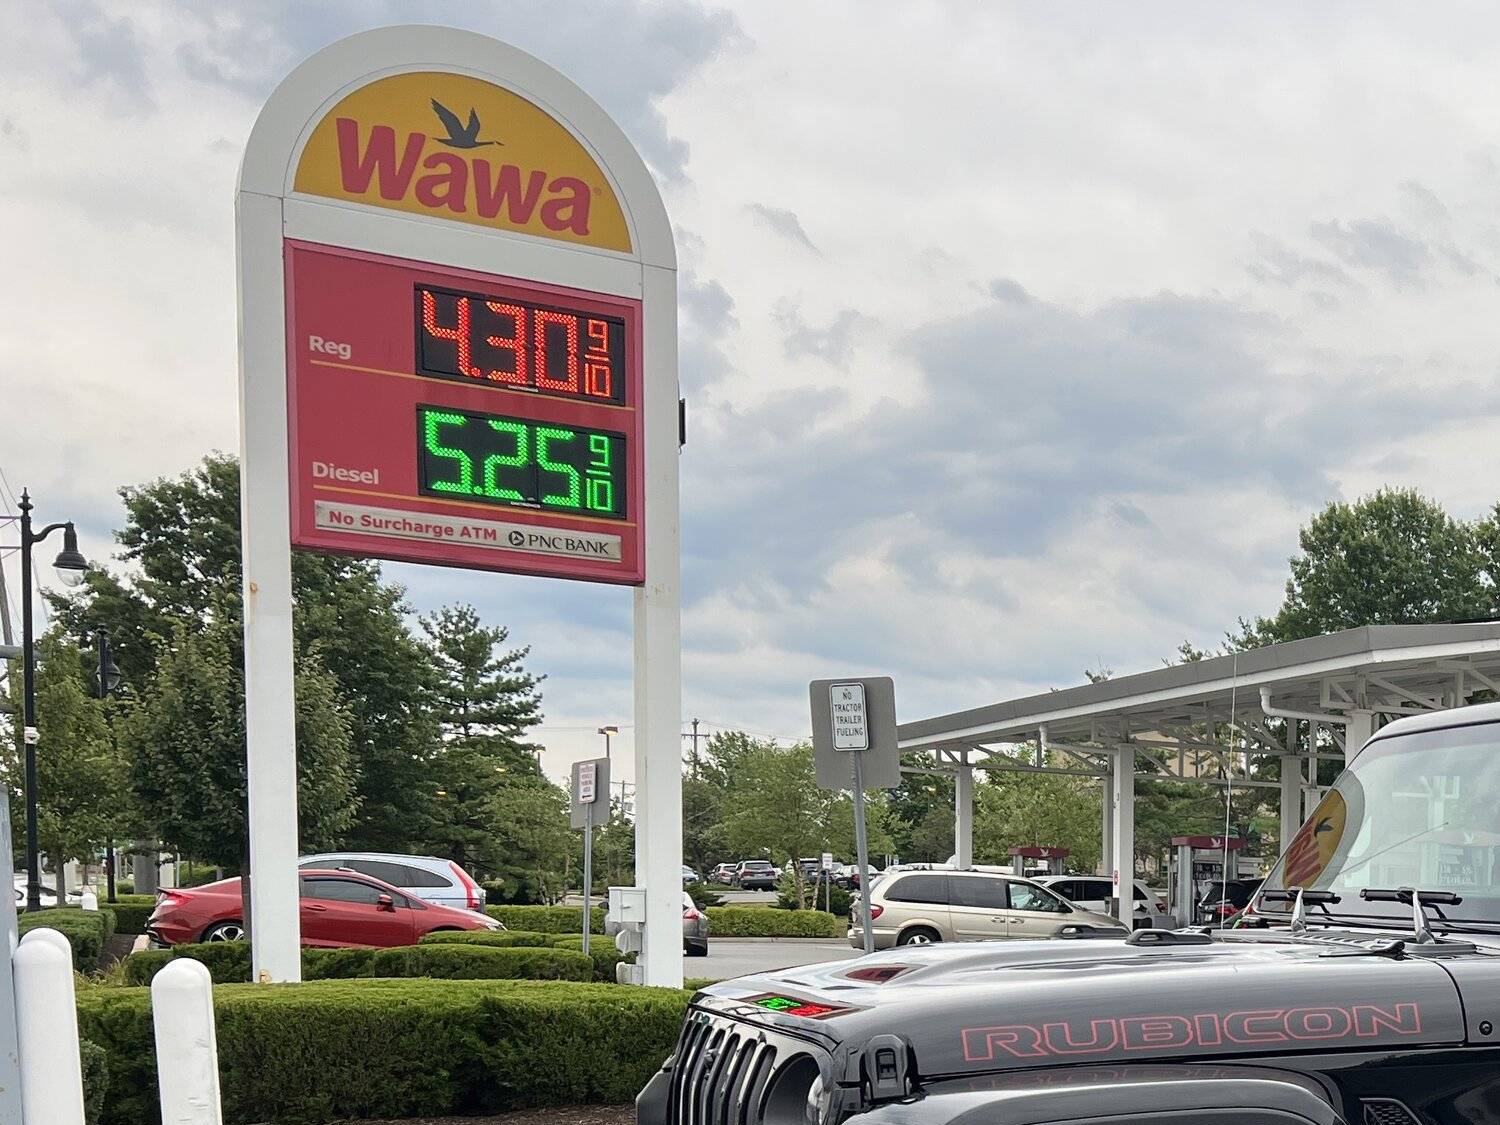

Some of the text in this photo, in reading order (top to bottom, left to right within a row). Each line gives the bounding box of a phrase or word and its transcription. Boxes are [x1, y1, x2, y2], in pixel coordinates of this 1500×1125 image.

[335, 117, 592, 236] Wawa
[309, 334, 352, 360] Reg
[422, 289, 579, 393] 4.30
[425, 410, 580, 508] 5.25
[311, 460, 380, 486] Diesel
[329, 509, 497, 542] No Surcharge ATM
[834, 702, 862, 713] TRACTOR
[842, 691, 852, 700] NO
[836, 715, 862, 725] TRAILER
[836, 727, 864, 737] FUELING
[961, 1002, 1423, 1062] RUBICON
